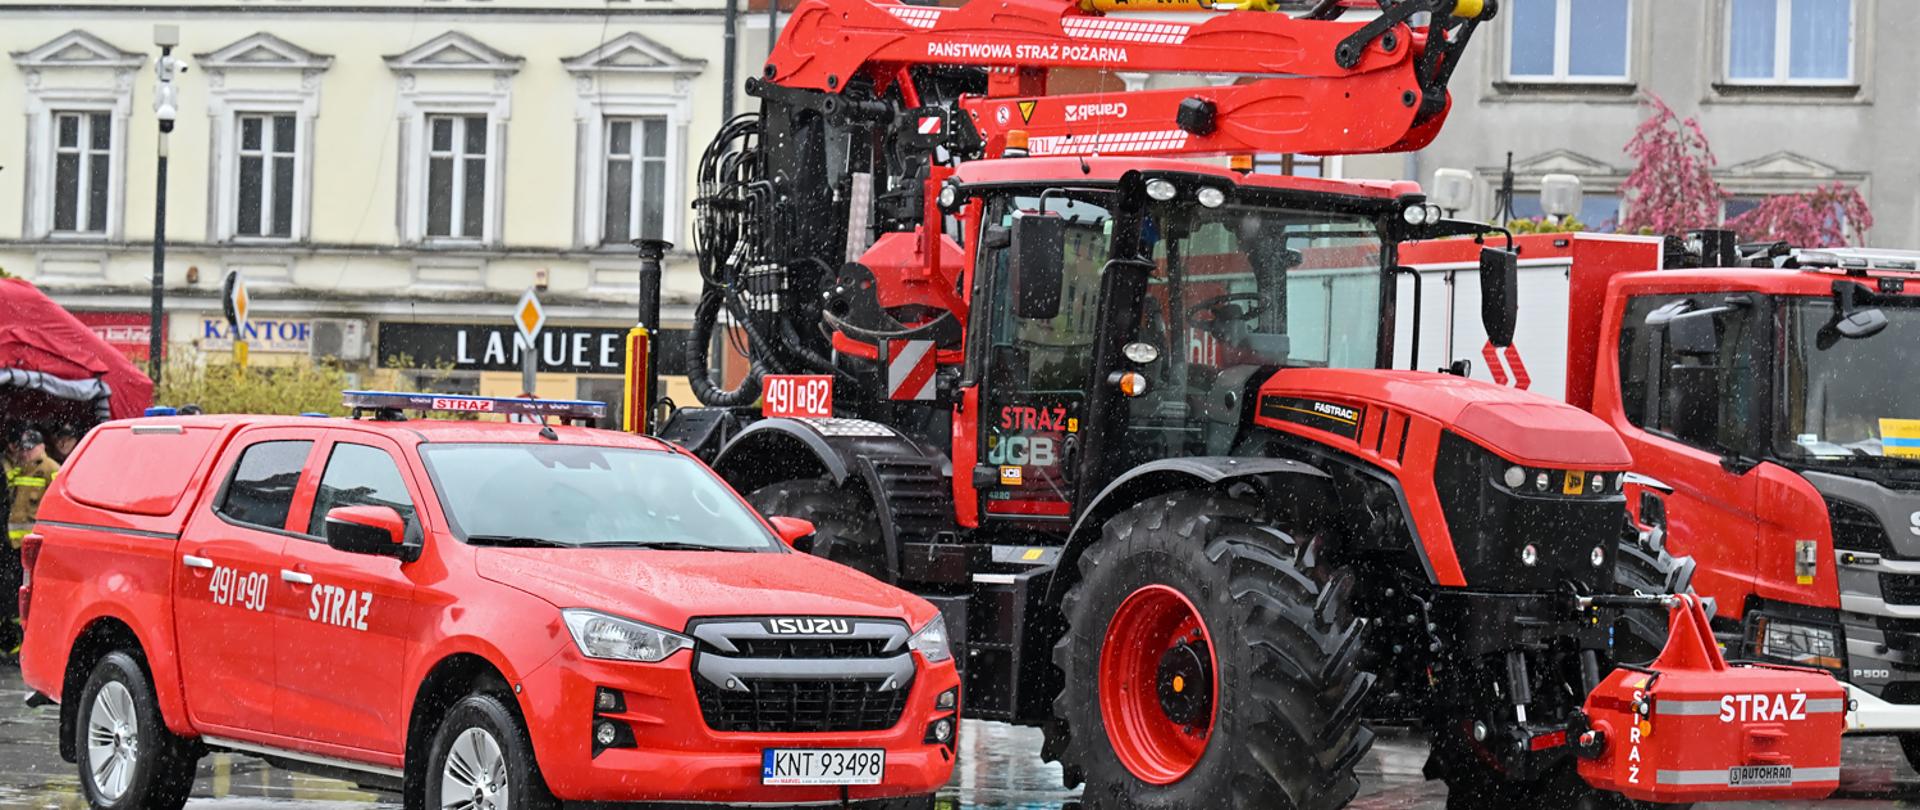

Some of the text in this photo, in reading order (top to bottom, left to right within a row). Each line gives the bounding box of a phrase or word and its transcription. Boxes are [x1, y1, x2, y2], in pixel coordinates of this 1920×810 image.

[928, 41, 1128, 62] PAŃSTWOWA STRAŻ POŻARNA
[1078, 102, 1127, 121] Cranab
[1001, 403, 1067, 431] STRAŻ
[988, 436, 1054, 466] JCB
[308, 584, 373, 631] STRAŻ
[770, 619, 849, 633] ISUZU
[1863, 669, 1889, 679] 500
[1719, 688, 1807, 722] STRAŻ
[764, 752, 880, 776] PL KNT 93498
[1741, 767, 1792, 779] AUTOKRAN
